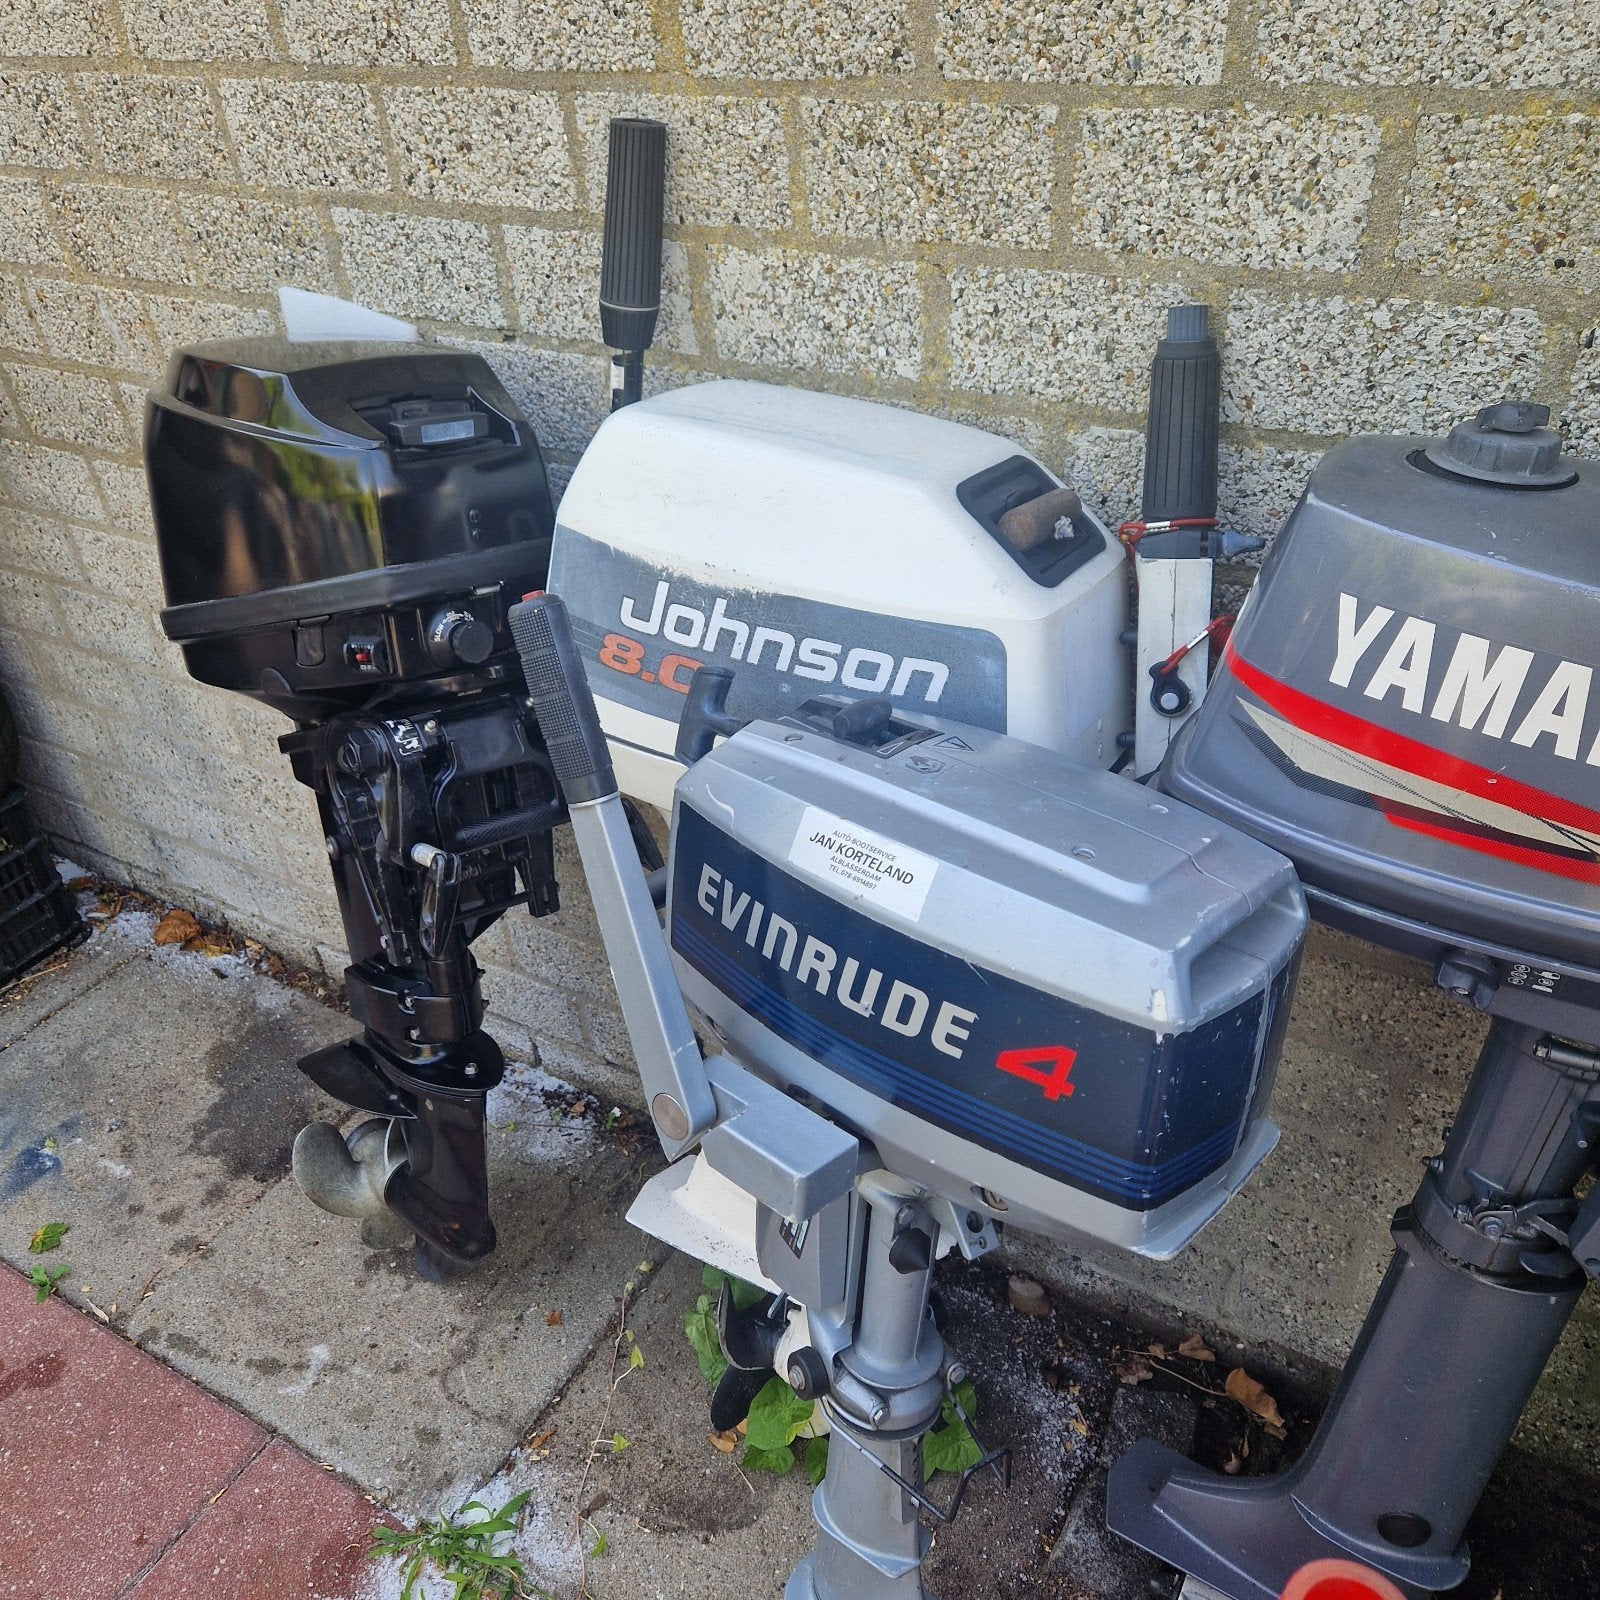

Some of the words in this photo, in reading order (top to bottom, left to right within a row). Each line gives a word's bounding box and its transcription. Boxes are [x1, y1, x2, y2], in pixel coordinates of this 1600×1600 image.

[619, 580, 950, 702] Johnson
[1328, 592, 1600, 768] YAMA
[809, 832, 836, 850] JAN
[836, 843, 914, 885] KORTELAND
[830, 855, 882, 882] ALBLASSERDAM
[832, 830, 897, 862] AUTO-BOOTSERVICE
[696, 862, 977, 1060] EVINRUDE
[995, 1044, 1077, 1101] 4
